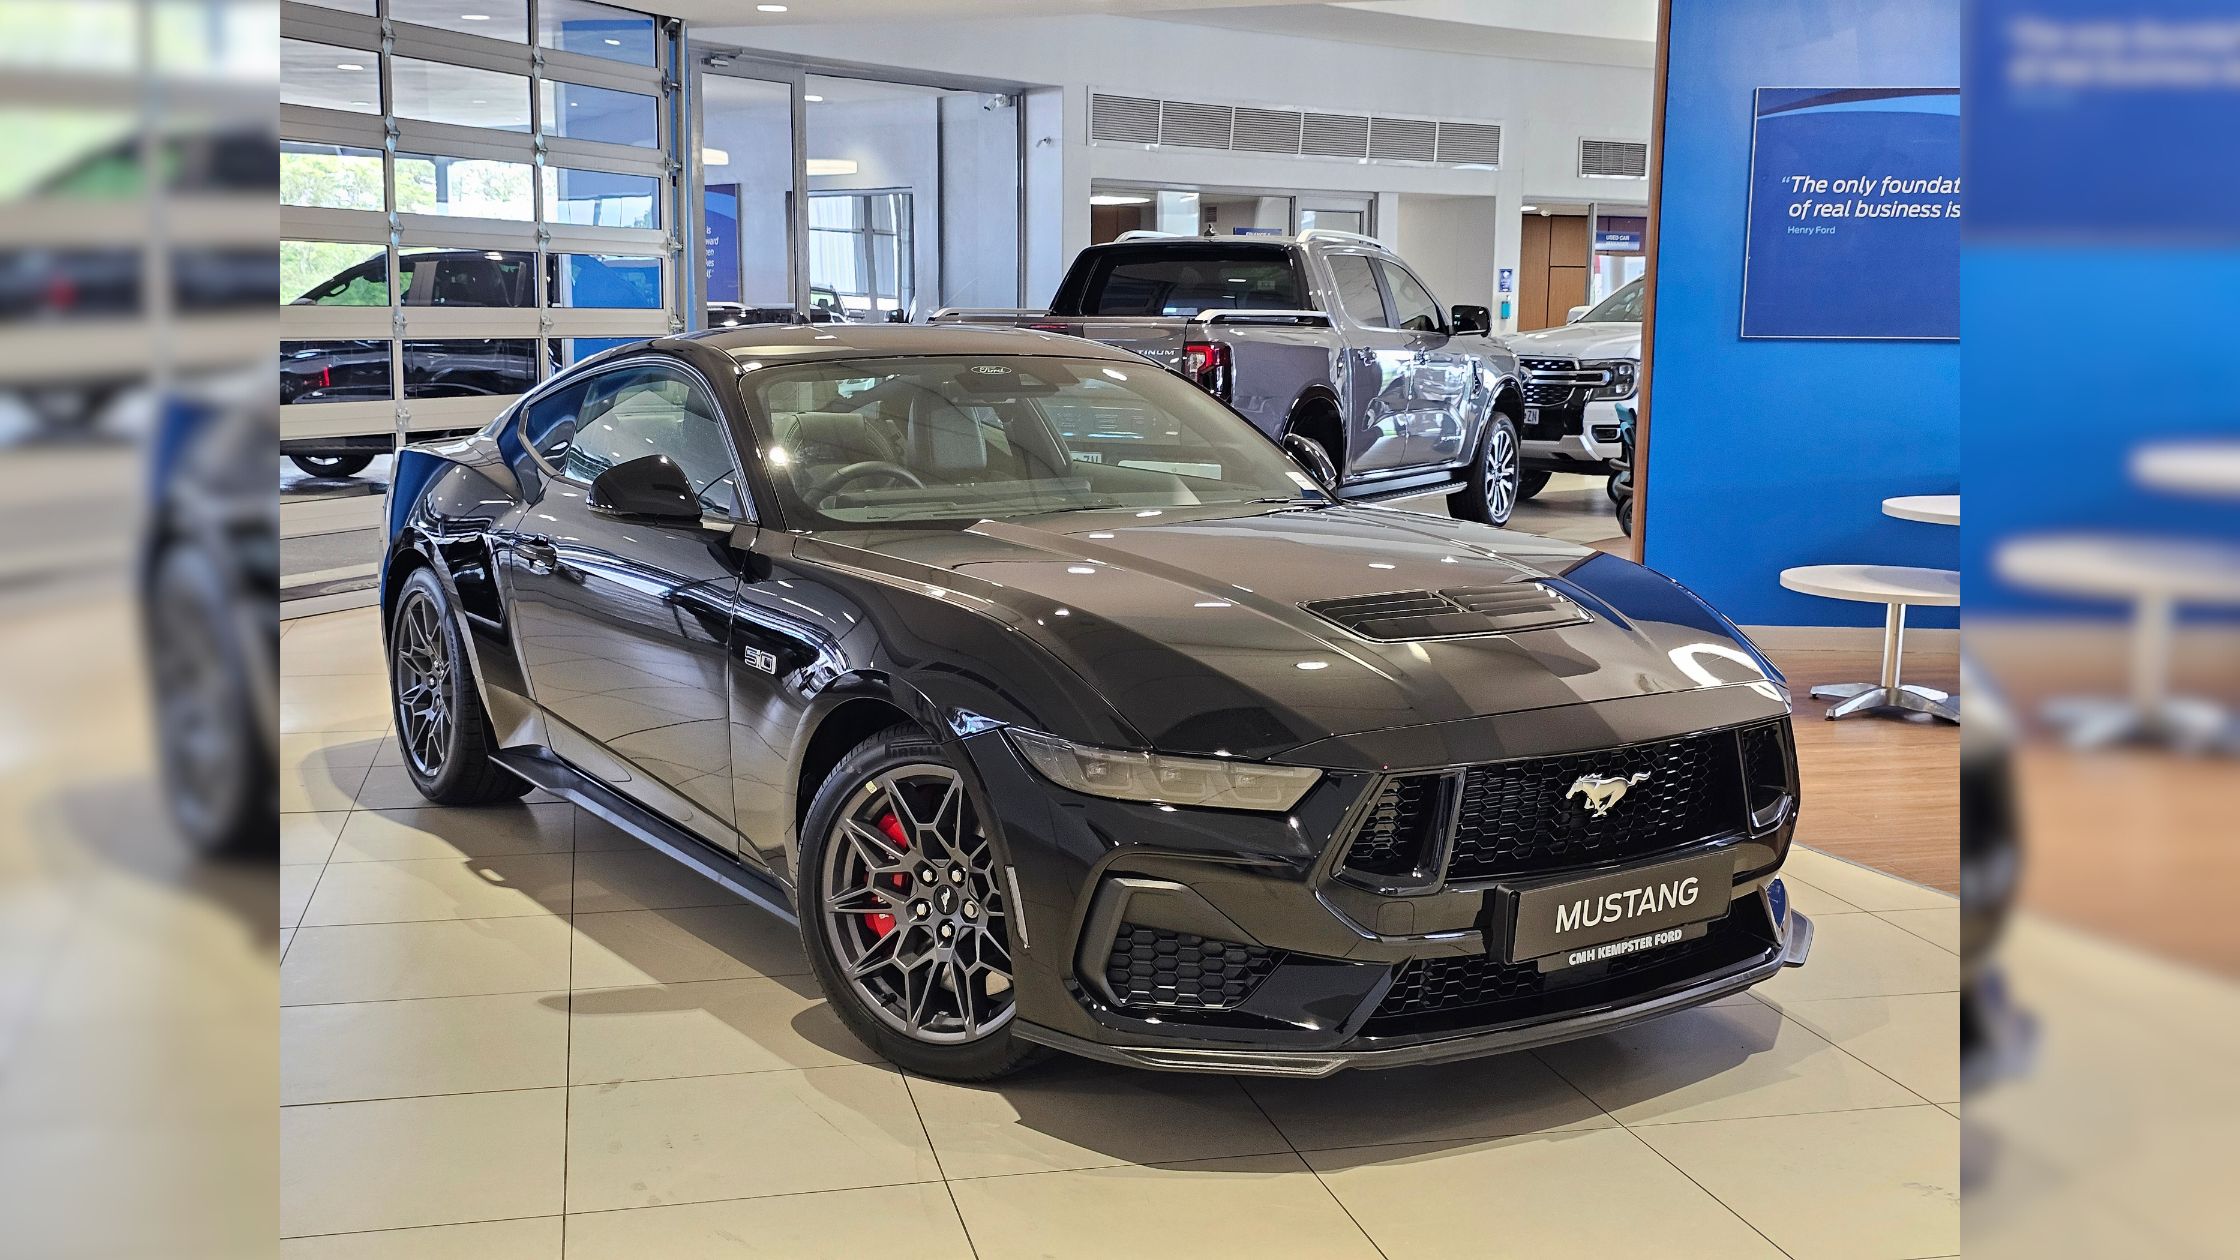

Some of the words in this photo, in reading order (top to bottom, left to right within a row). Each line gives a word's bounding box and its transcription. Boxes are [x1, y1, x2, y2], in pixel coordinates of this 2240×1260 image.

[1832, 175, 1877, 197] only
[1879, 175, 1960, 197] foundat
[1788, 200, 1813, 220] of
[1813, 200, 1851, 218] real
[1854, 200, 1942, 218] business
[1944, 201, 1960, 218] is
[1787, 226, 1814, 236] Henry
[1815, 226, 1836, 234] Ford
[1555, 876, 1699, 934] MUSTANG
[1568, 948, 1596, 966] CMH
[1597, 934, 1653, 960] KEMPSTER
[1654, 929, 1683, 947] FORD
